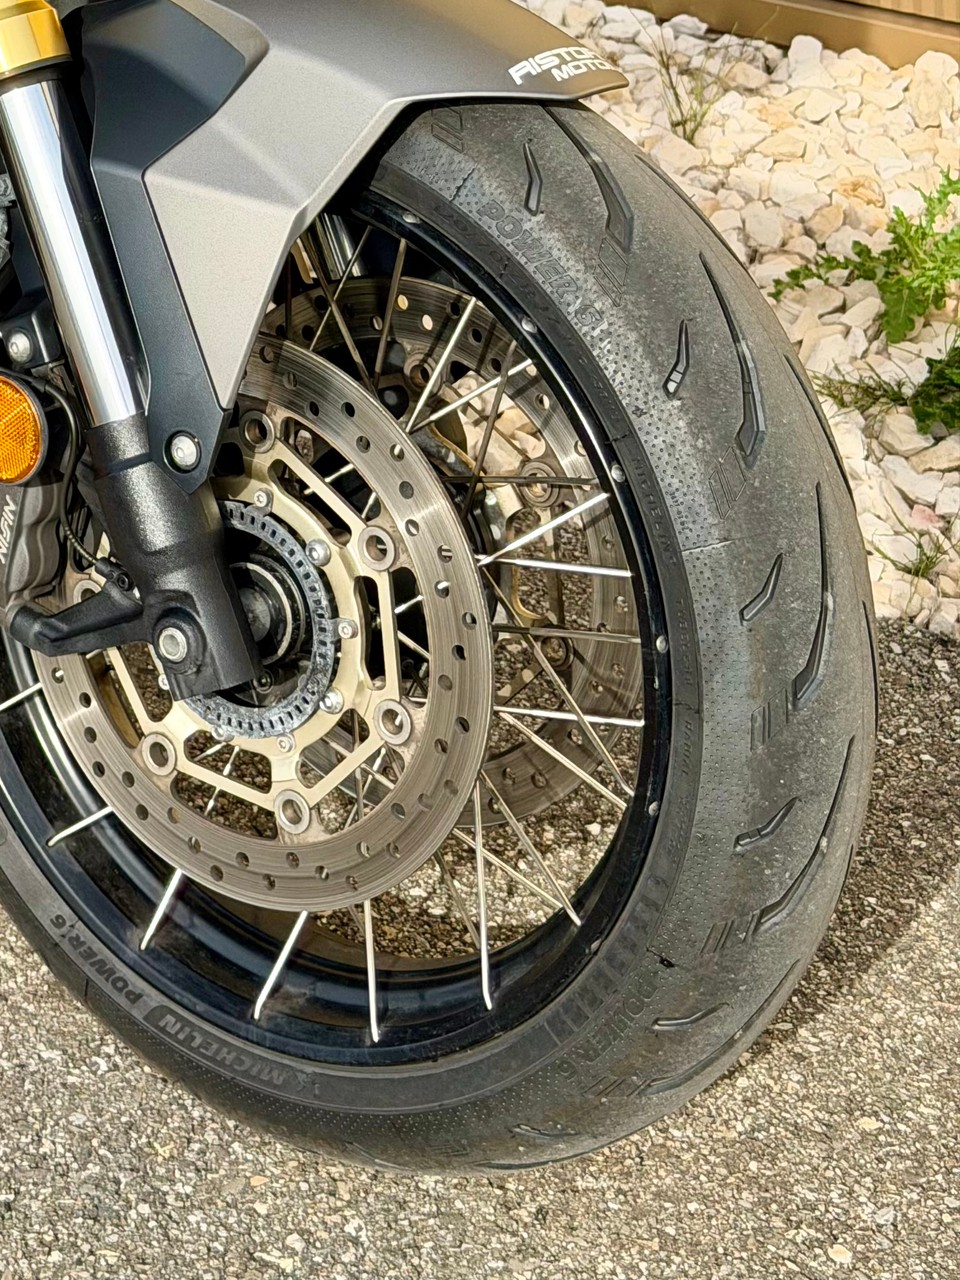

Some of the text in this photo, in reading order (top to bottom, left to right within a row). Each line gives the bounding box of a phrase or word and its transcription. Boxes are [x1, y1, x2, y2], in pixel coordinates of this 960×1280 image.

[550, 59, 615, 82] MOTO
[476, 199, 603, 327] POWER 6
[49, 913, 287, 1086] MICHELIN POWER 6
